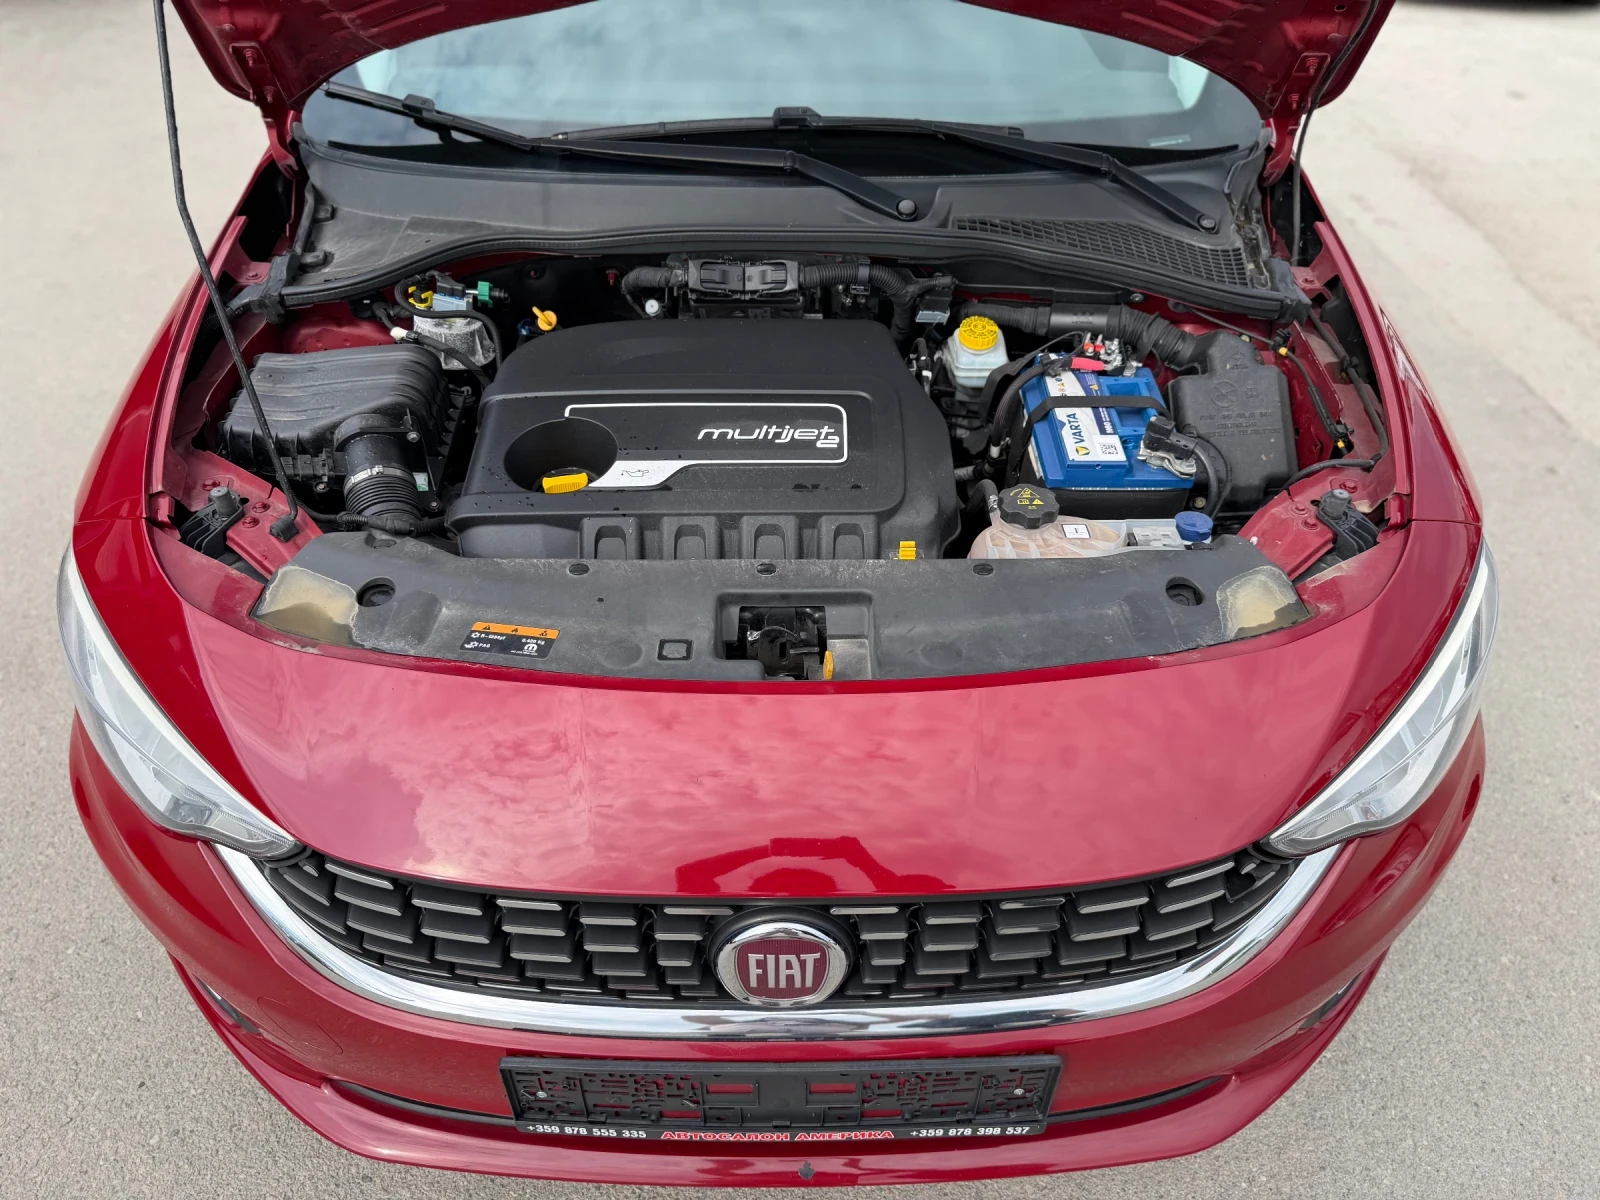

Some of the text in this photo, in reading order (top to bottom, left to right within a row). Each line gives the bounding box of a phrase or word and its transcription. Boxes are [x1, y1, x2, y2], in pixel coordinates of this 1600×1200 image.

[697, 425, 835, 443] multijet
[1066, 412, 1085, 444] VARTA
[748, 952, 821, 988] FIAT
[527, 1124, 647, 1138] +359 878 555 335
[661, 1130, 895, 1141] АВТОСАЛОН АМЕРИКА
[910, 1126, 1031, 1137] +359 878 398 537
